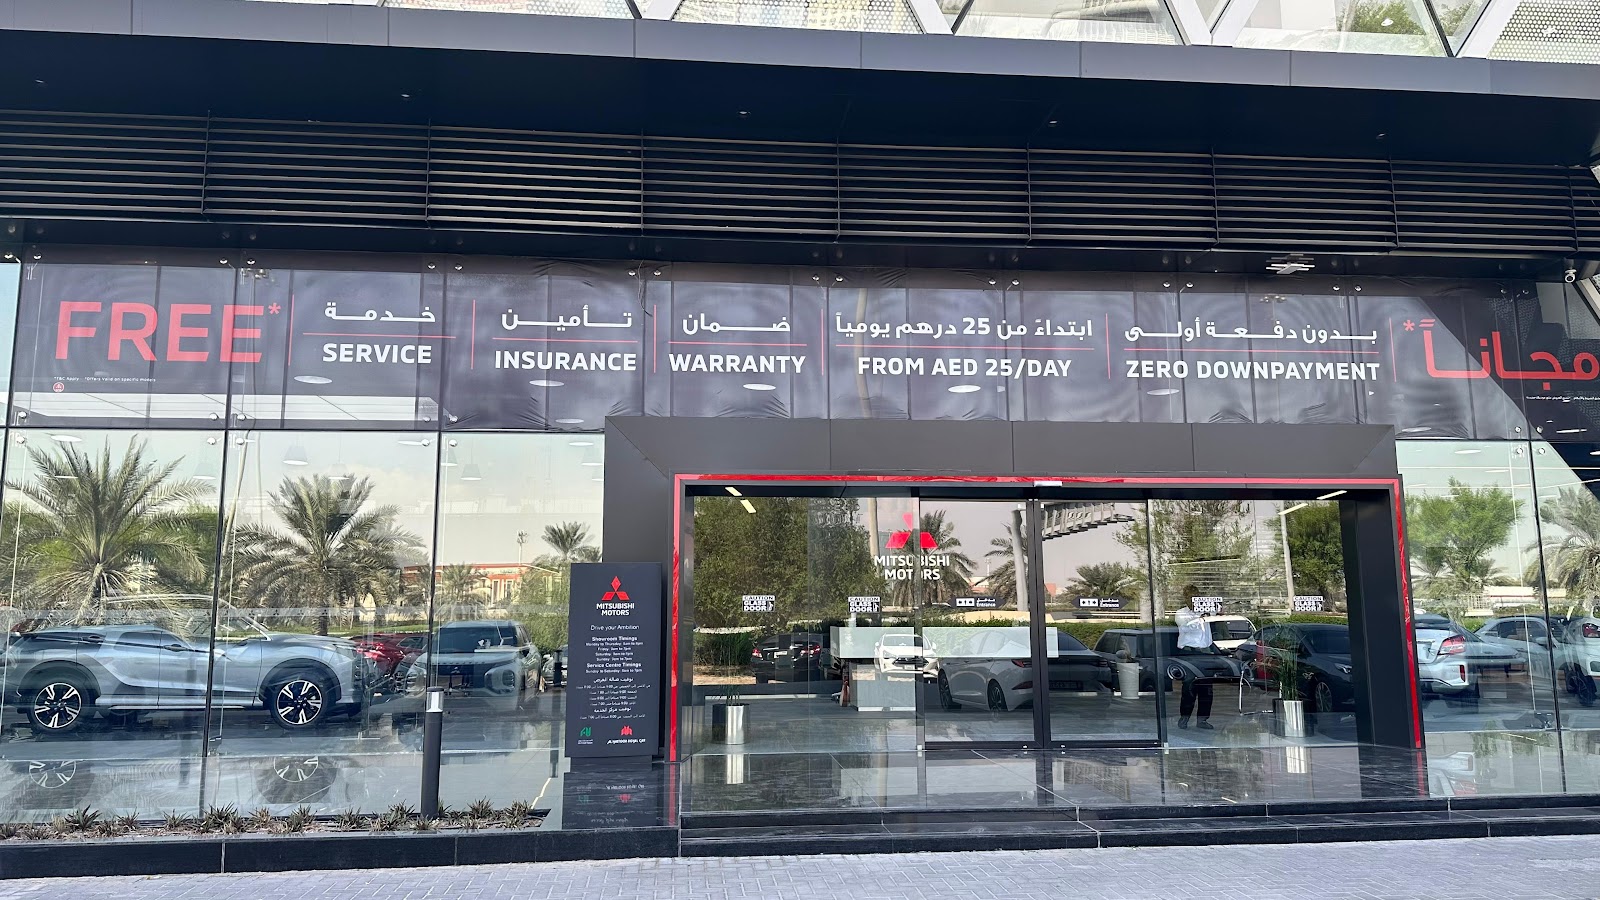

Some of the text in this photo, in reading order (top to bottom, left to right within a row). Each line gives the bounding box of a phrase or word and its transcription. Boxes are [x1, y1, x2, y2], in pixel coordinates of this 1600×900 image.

[324, 301, 436, 323] خدمة
[501, 304, 632, 332] تأمين
[682, 313, 791, 336] ضمان
[895, 320, 957, 339] درهم
[962, 317, 990, 335] 25
[997, 319, 1027, 340] من
[1124, 317, 1378, 345] بدون دفعة أولى
[322, 342, 432, 364] SERVICE
[494, 350, 637, 372] INSURANCE
[668, 353, 807, 374] WARRANTY
[858, 357, 1072, 380] FROM AED 25/DAY
[1126, 360, 1380, 381] ZERO DOWNPAYMENT
[884, 568, 940, 580] MOTRS
